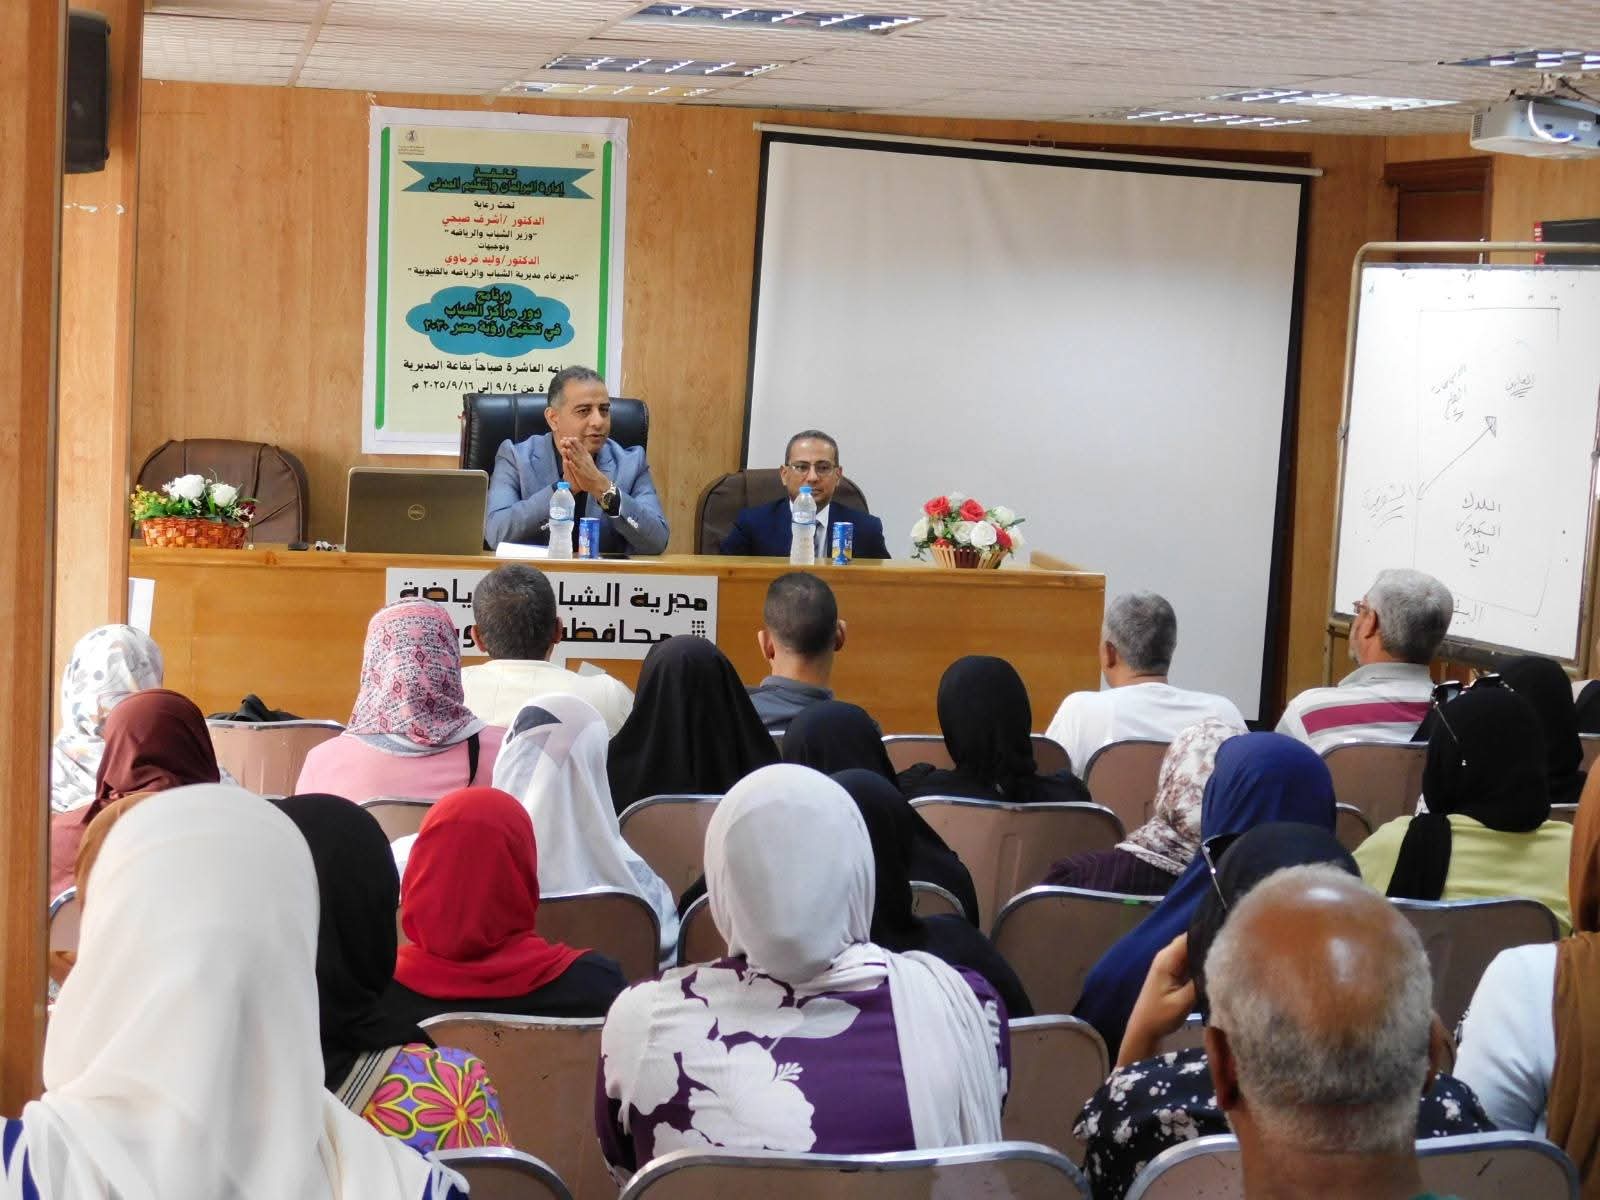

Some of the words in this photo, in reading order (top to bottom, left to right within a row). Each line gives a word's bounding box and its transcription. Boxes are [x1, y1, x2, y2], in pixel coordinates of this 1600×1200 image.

[474, 200, 495, 211] رعاية
[497, 201, 515, 209] تحت
[512, 216, 545, 229] الدكتور
[486, 229, 513, 239] الشباب
[486, 269, 513, 280] الشباب
[515, 270, 541, 281] مديرية
[475, 286, 513, 305] برنامج
[444, 301, 485, 319] الشباب
[484, 303, 517, 321] مراكز
[517, 306, 542, 321] دور
[450, 322, 477, 336] مصر
[477, 320, 505, 338] رؤية
[507, 321, 544, 338] تحقيق
[543, 323, 563, 341] في
[403, 359, 443, 373] المديرية
[446, 361, 472, 374] بقاعة
[506, 363, 544, 376] العاشرة
[411, 384, 419, 393] م
[521, 384, 535, 395] من
[559, 582, 620, 611] الشبا
[561, 618, 672, 643] محافظ
